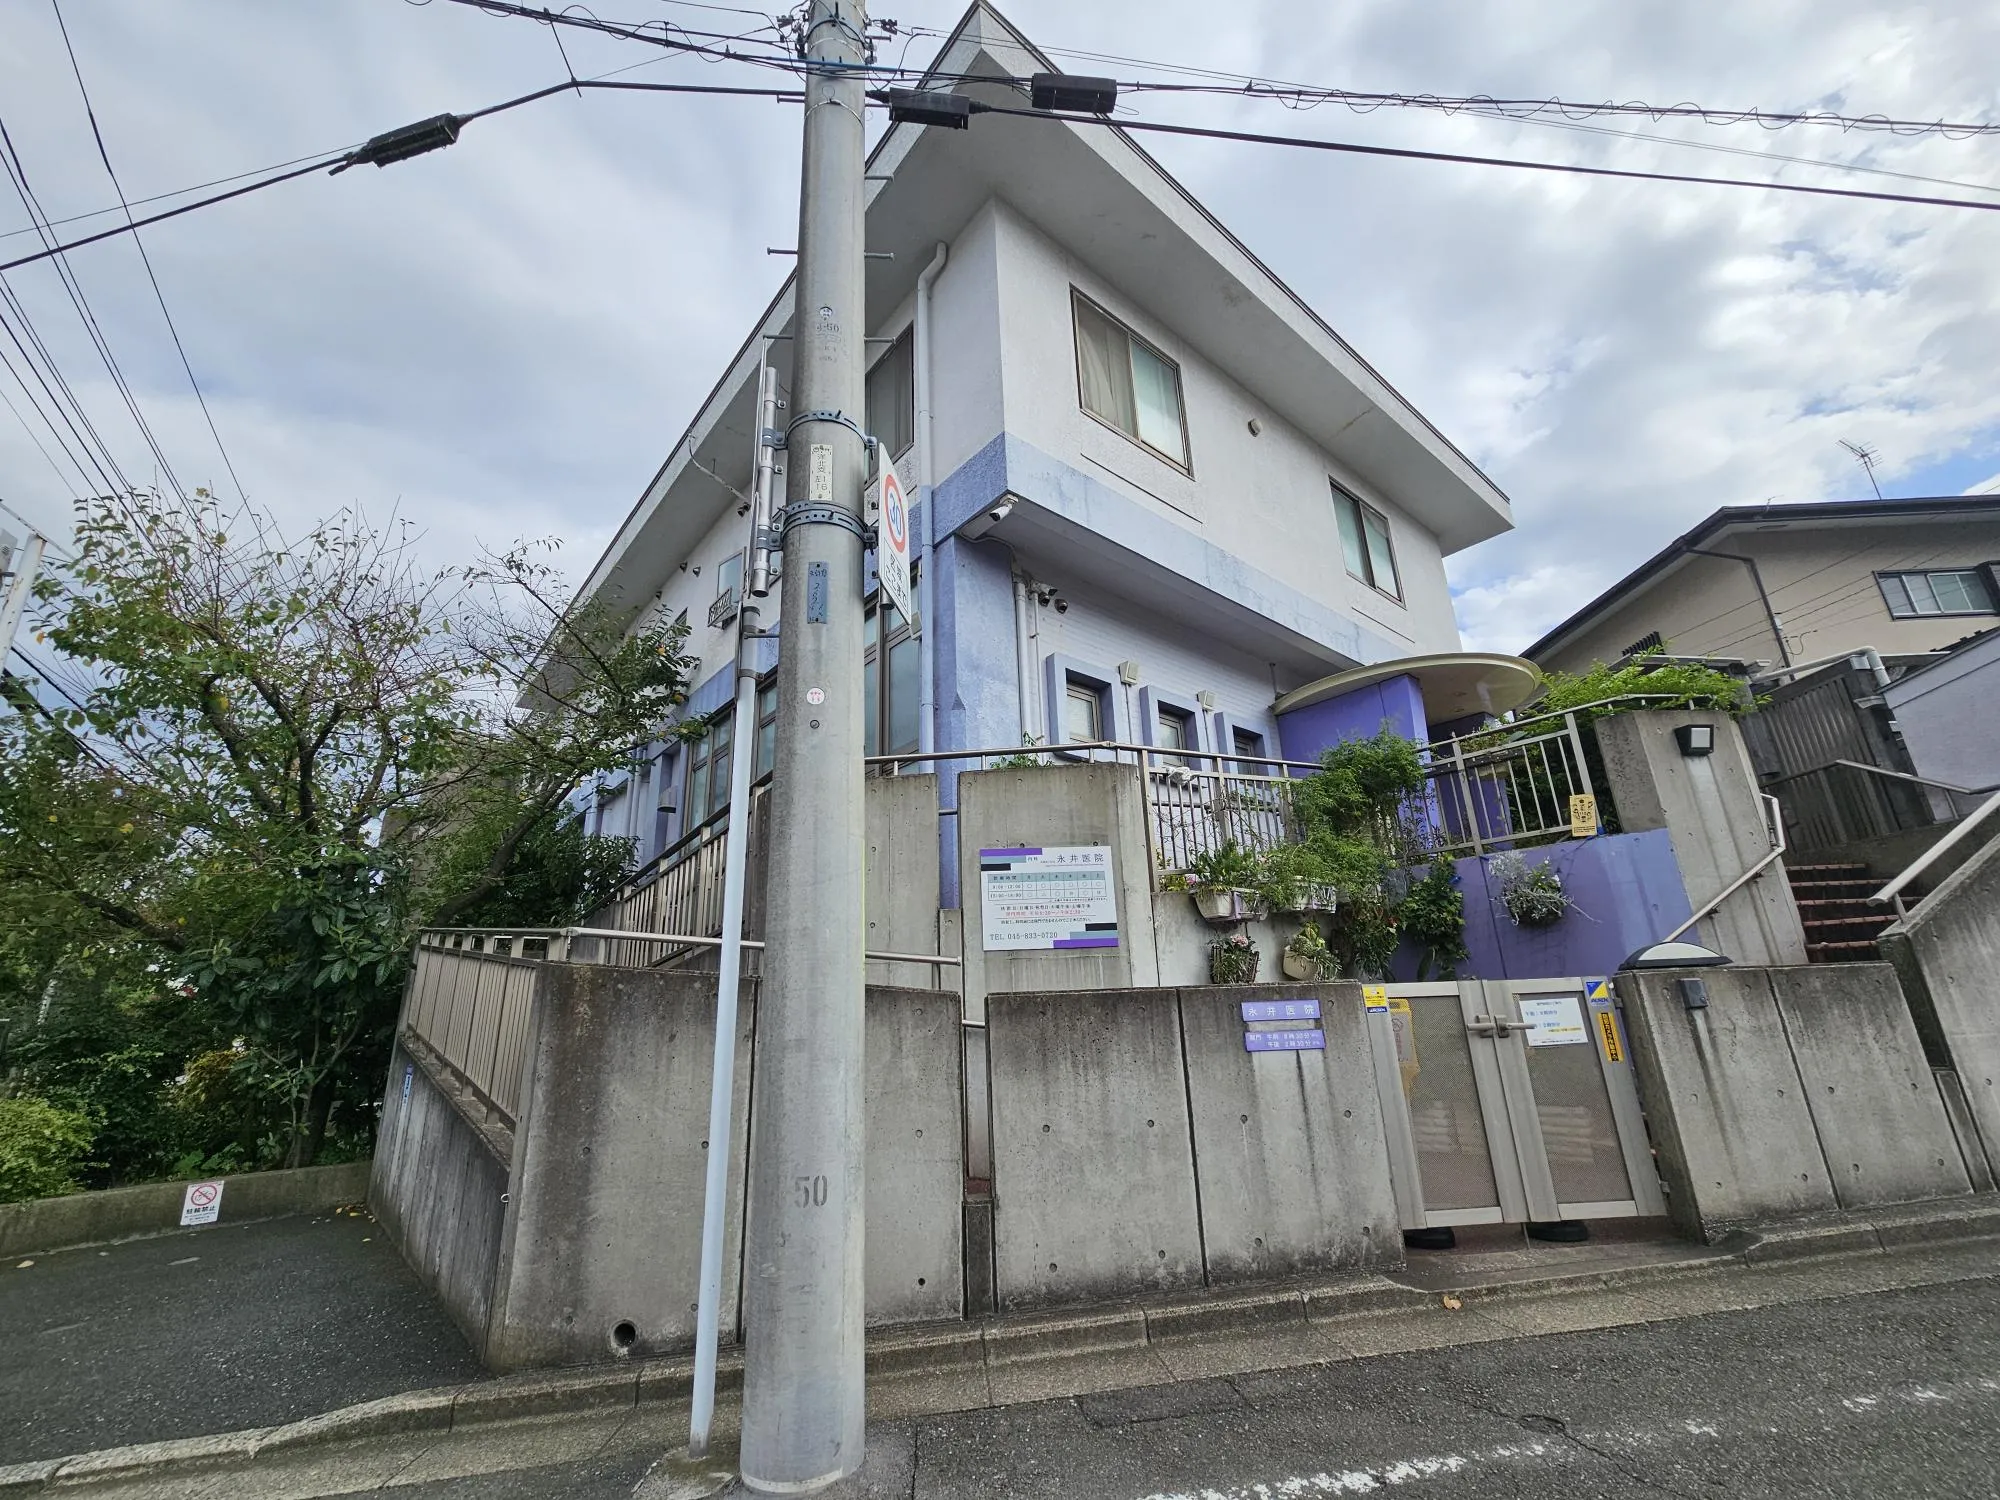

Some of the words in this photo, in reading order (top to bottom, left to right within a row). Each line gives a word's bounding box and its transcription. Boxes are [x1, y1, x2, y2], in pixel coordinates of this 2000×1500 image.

[889, 492, 901, 536] 30
[1007, 932, 1058, 940] 045-833-0720
[1248, 1004, 1315, 1017] 永井医院
[793, 1174, 829, 1208] 50
